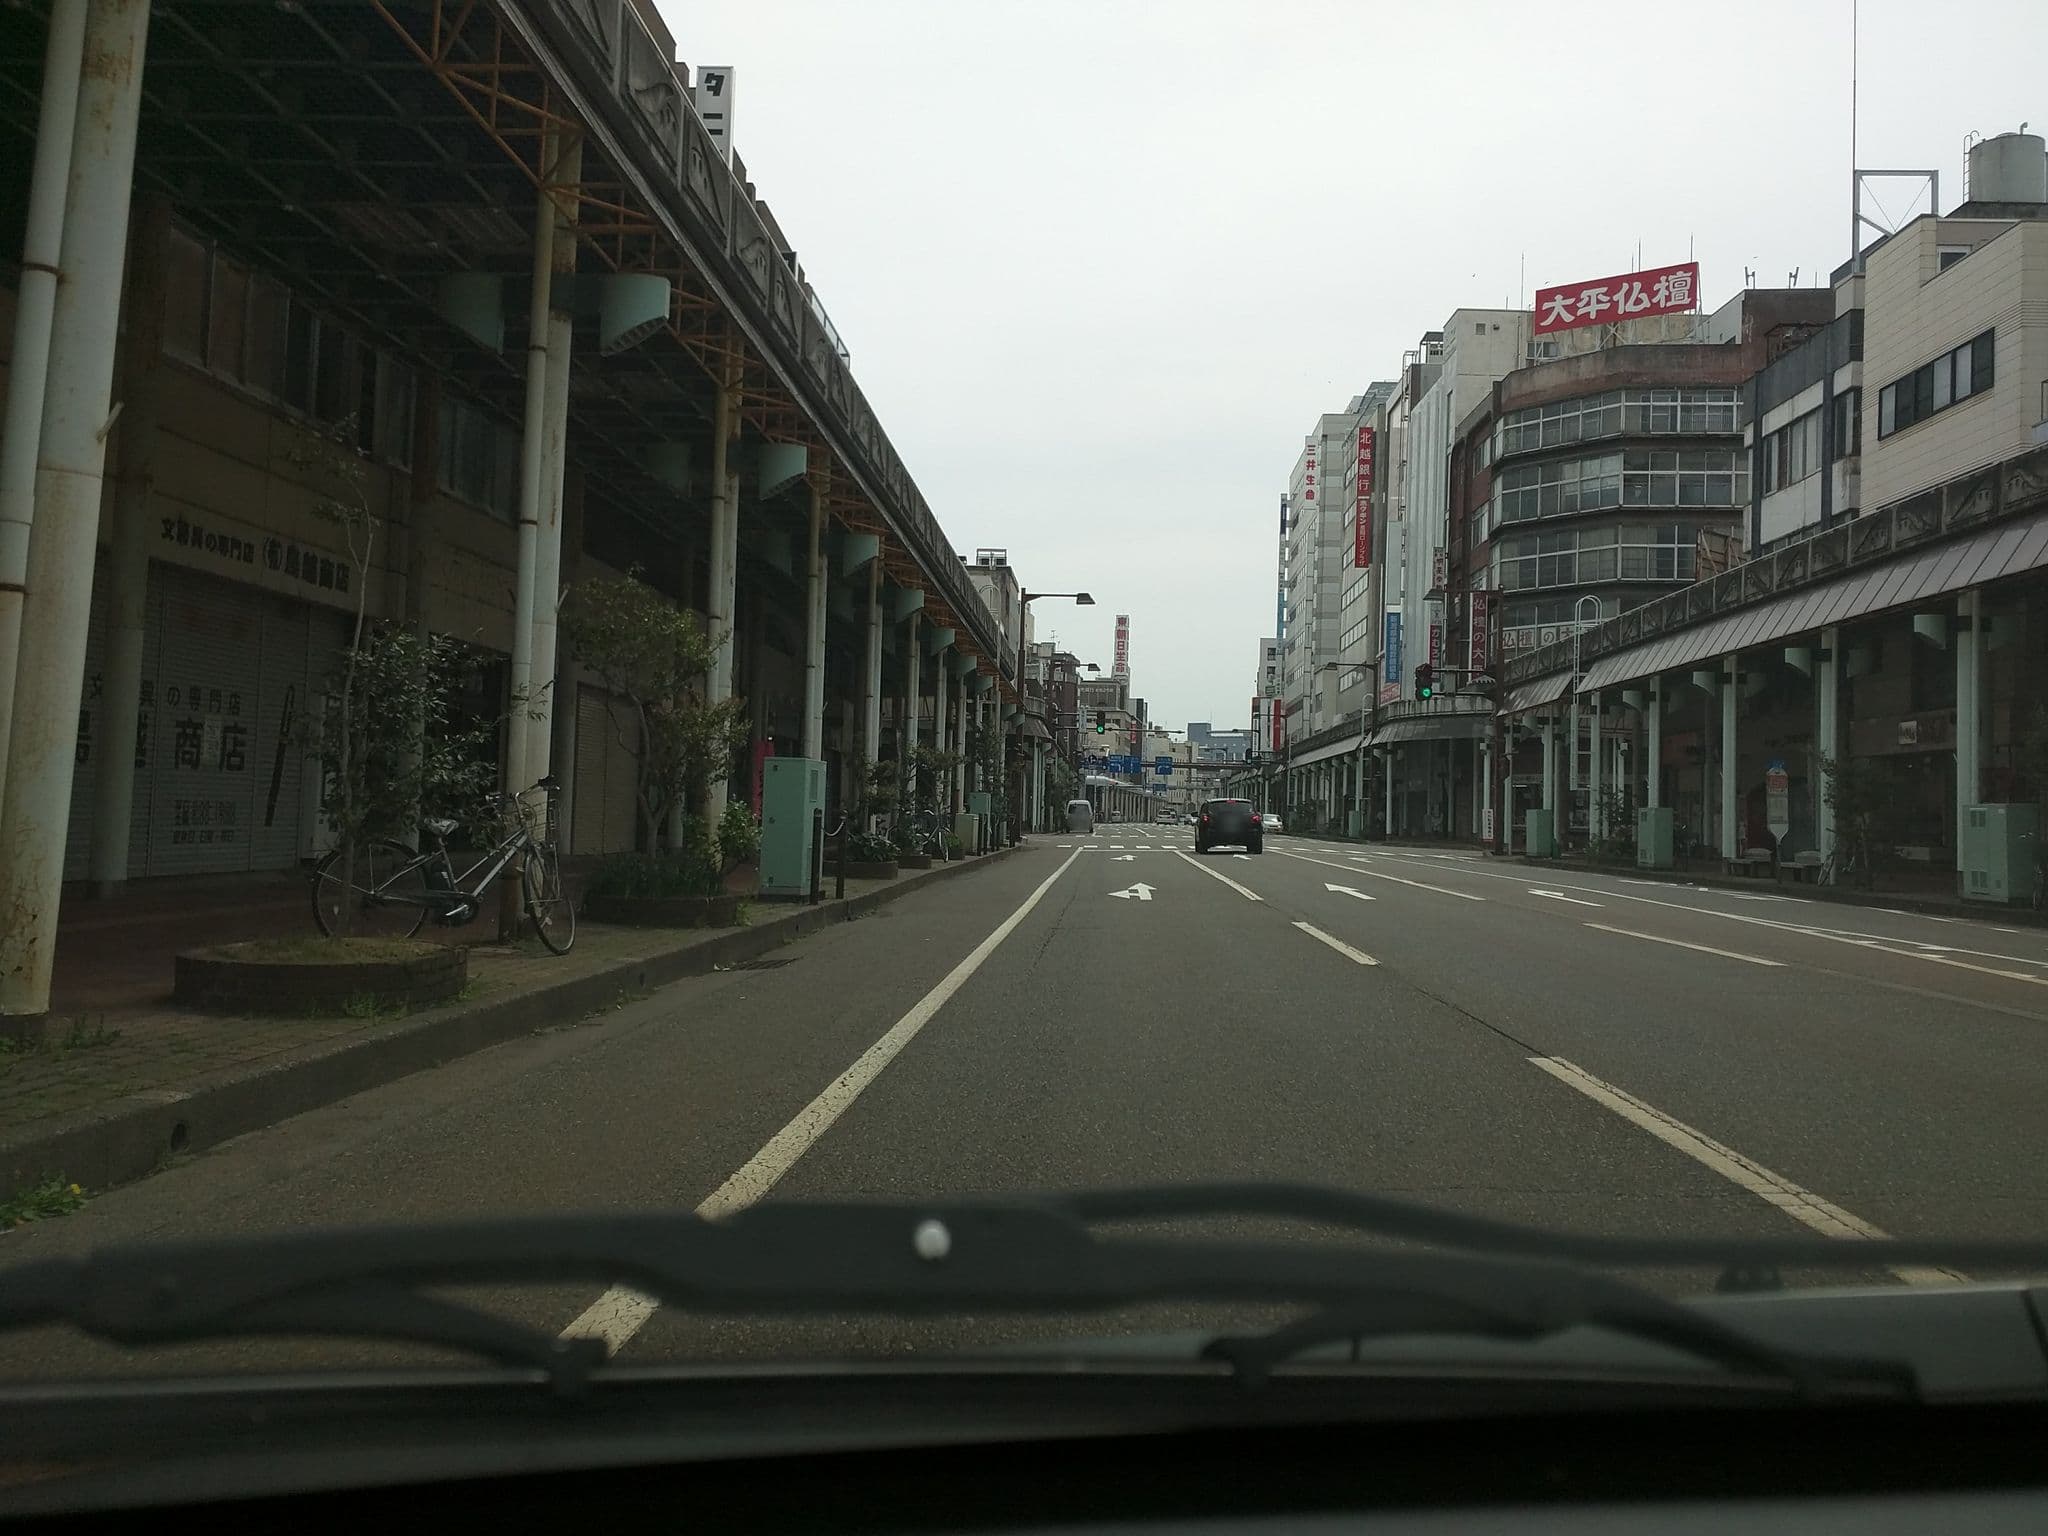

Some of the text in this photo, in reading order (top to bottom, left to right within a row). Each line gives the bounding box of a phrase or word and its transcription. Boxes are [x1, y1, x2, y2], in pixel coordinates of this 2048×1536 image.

[1305, 444, 1317, 500] 三井生命
[1358, 431, 1372, 491] 北越銀行
